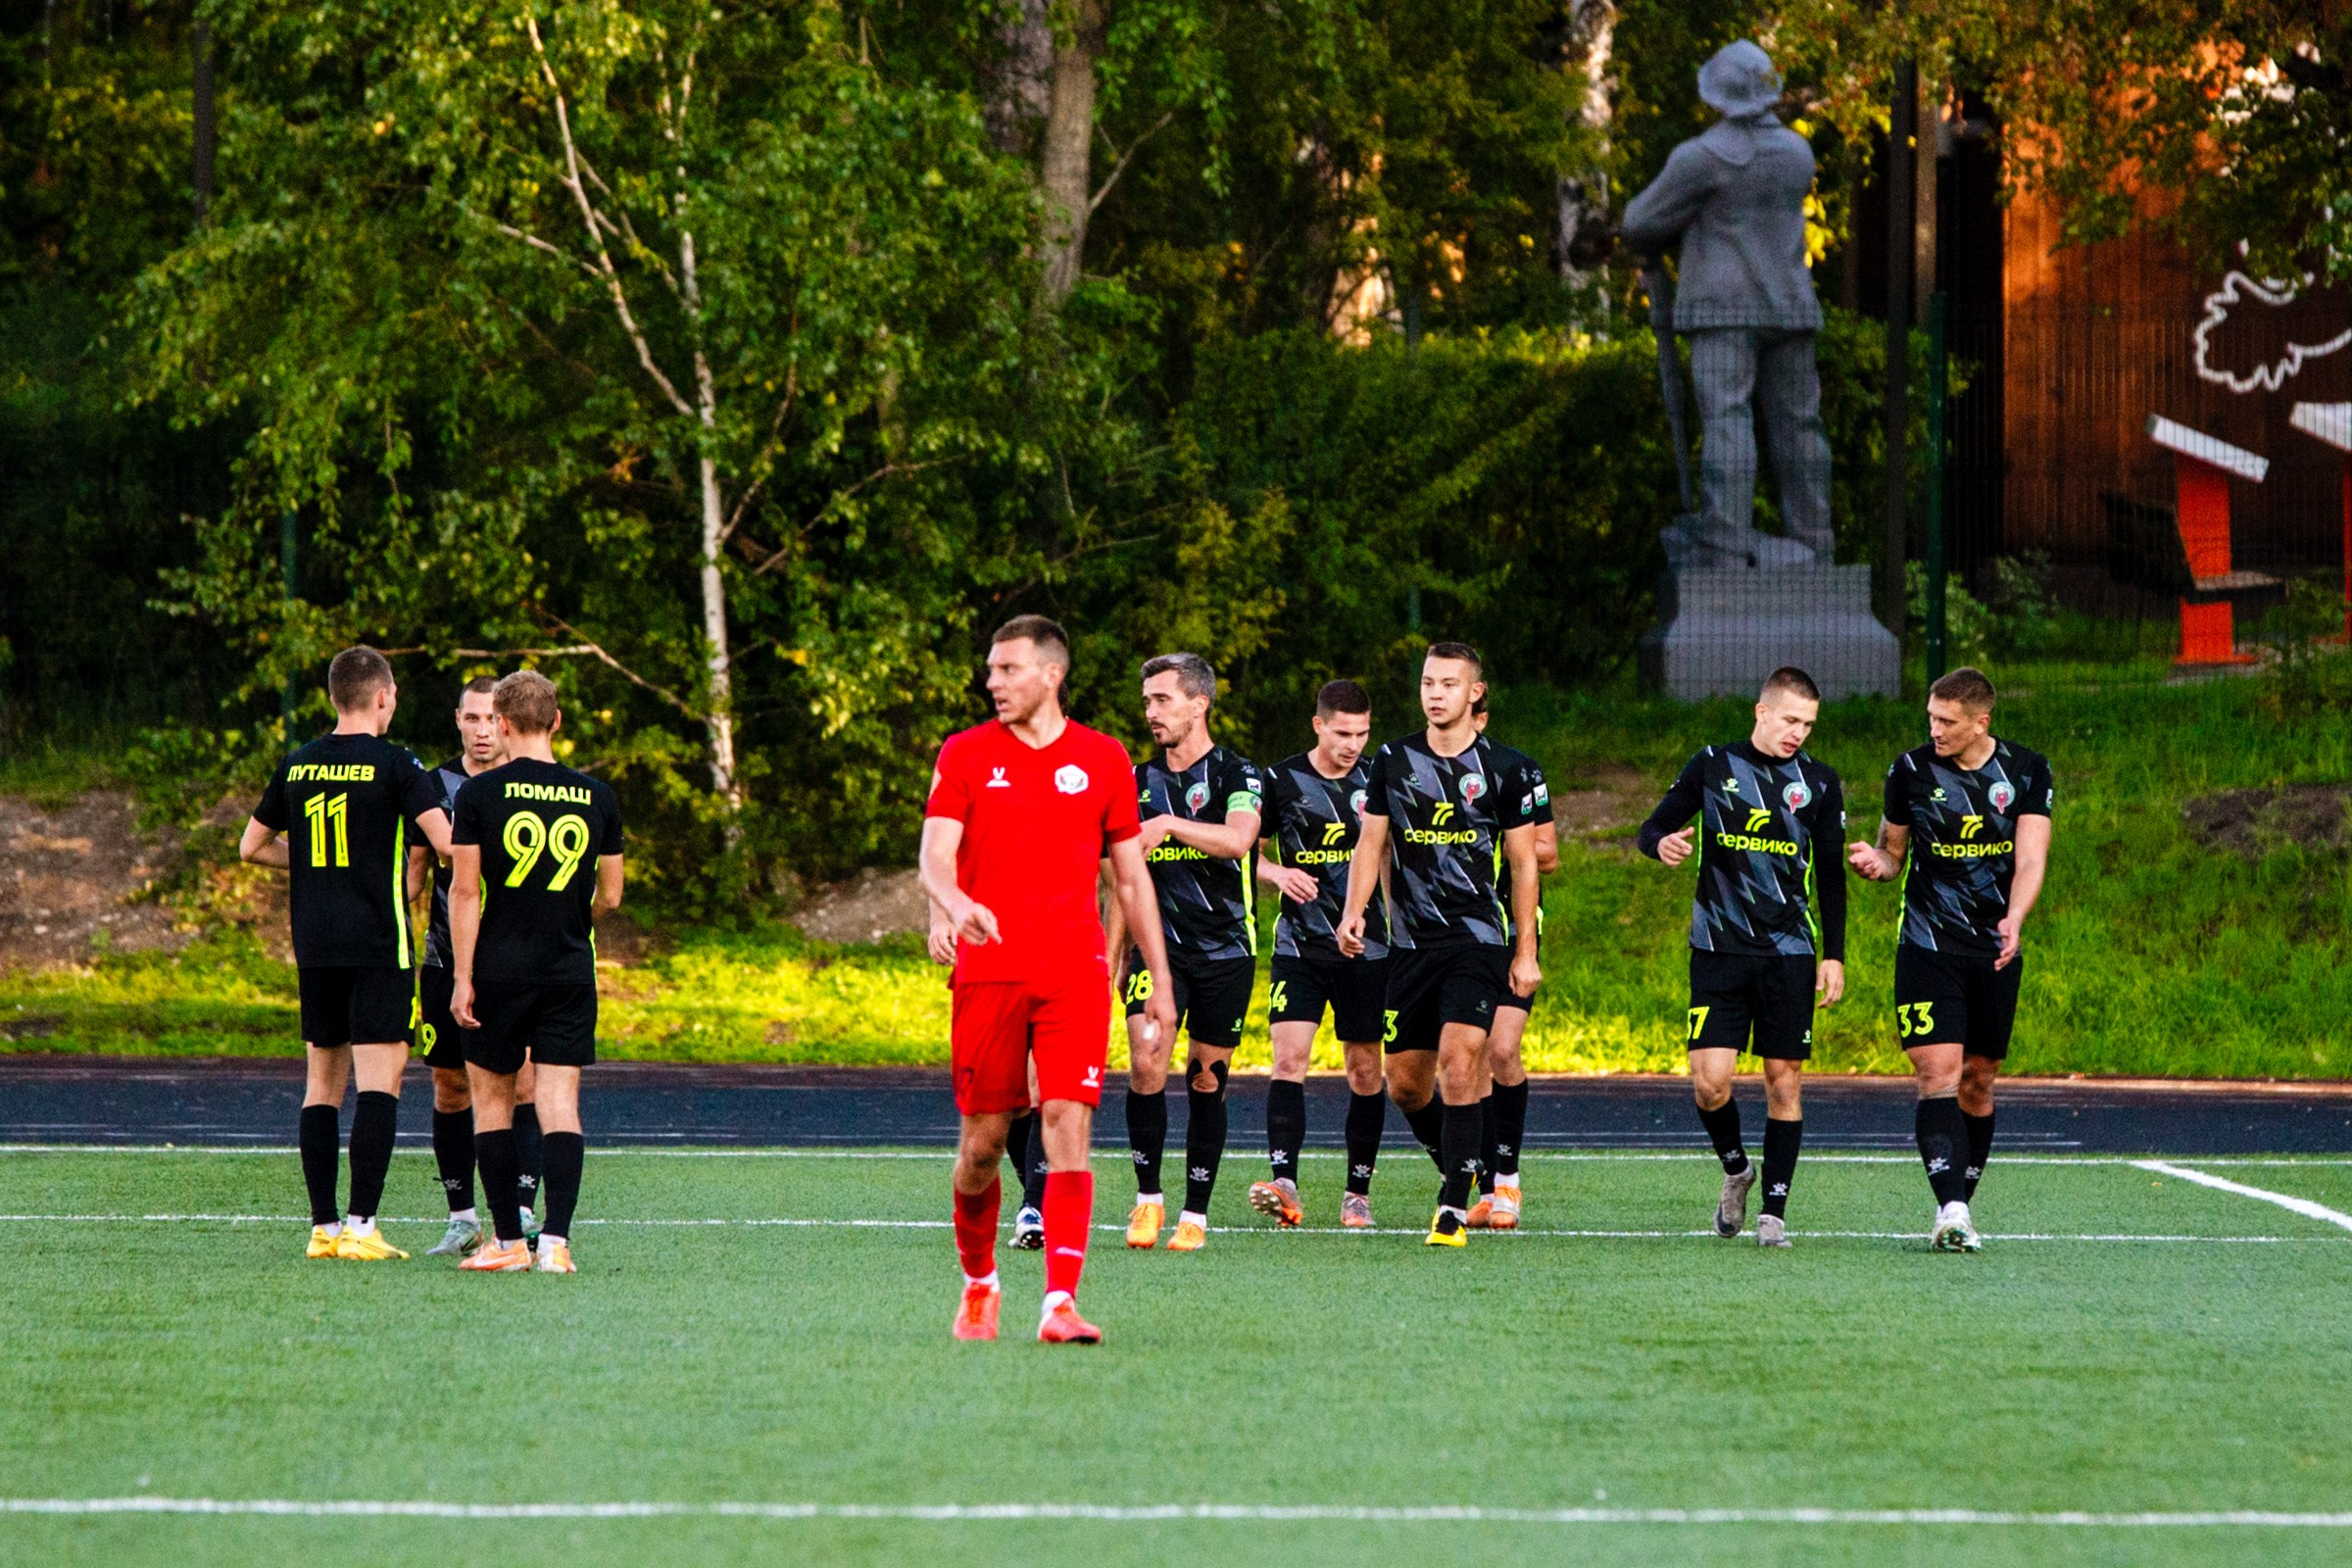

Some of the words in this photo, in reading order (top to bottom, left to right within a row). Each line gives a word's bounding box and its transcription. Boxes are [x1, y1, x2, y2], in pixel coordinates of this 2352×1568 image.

[504, 782, 592, 806] ЛОМАШ
[304, 791, 350, 867] 11
[1404, 828, 1478, 845] сервико
[503, 810, 590, 892] 99
[1295, 848, 1355, 865] серви
[1716, 832, 1798, 857] сервико
[1931, 840, 2014, 859] сервико
[1268, 980, 1288, 1012] 4
[1897, 1001, 1936, 1039] 33
